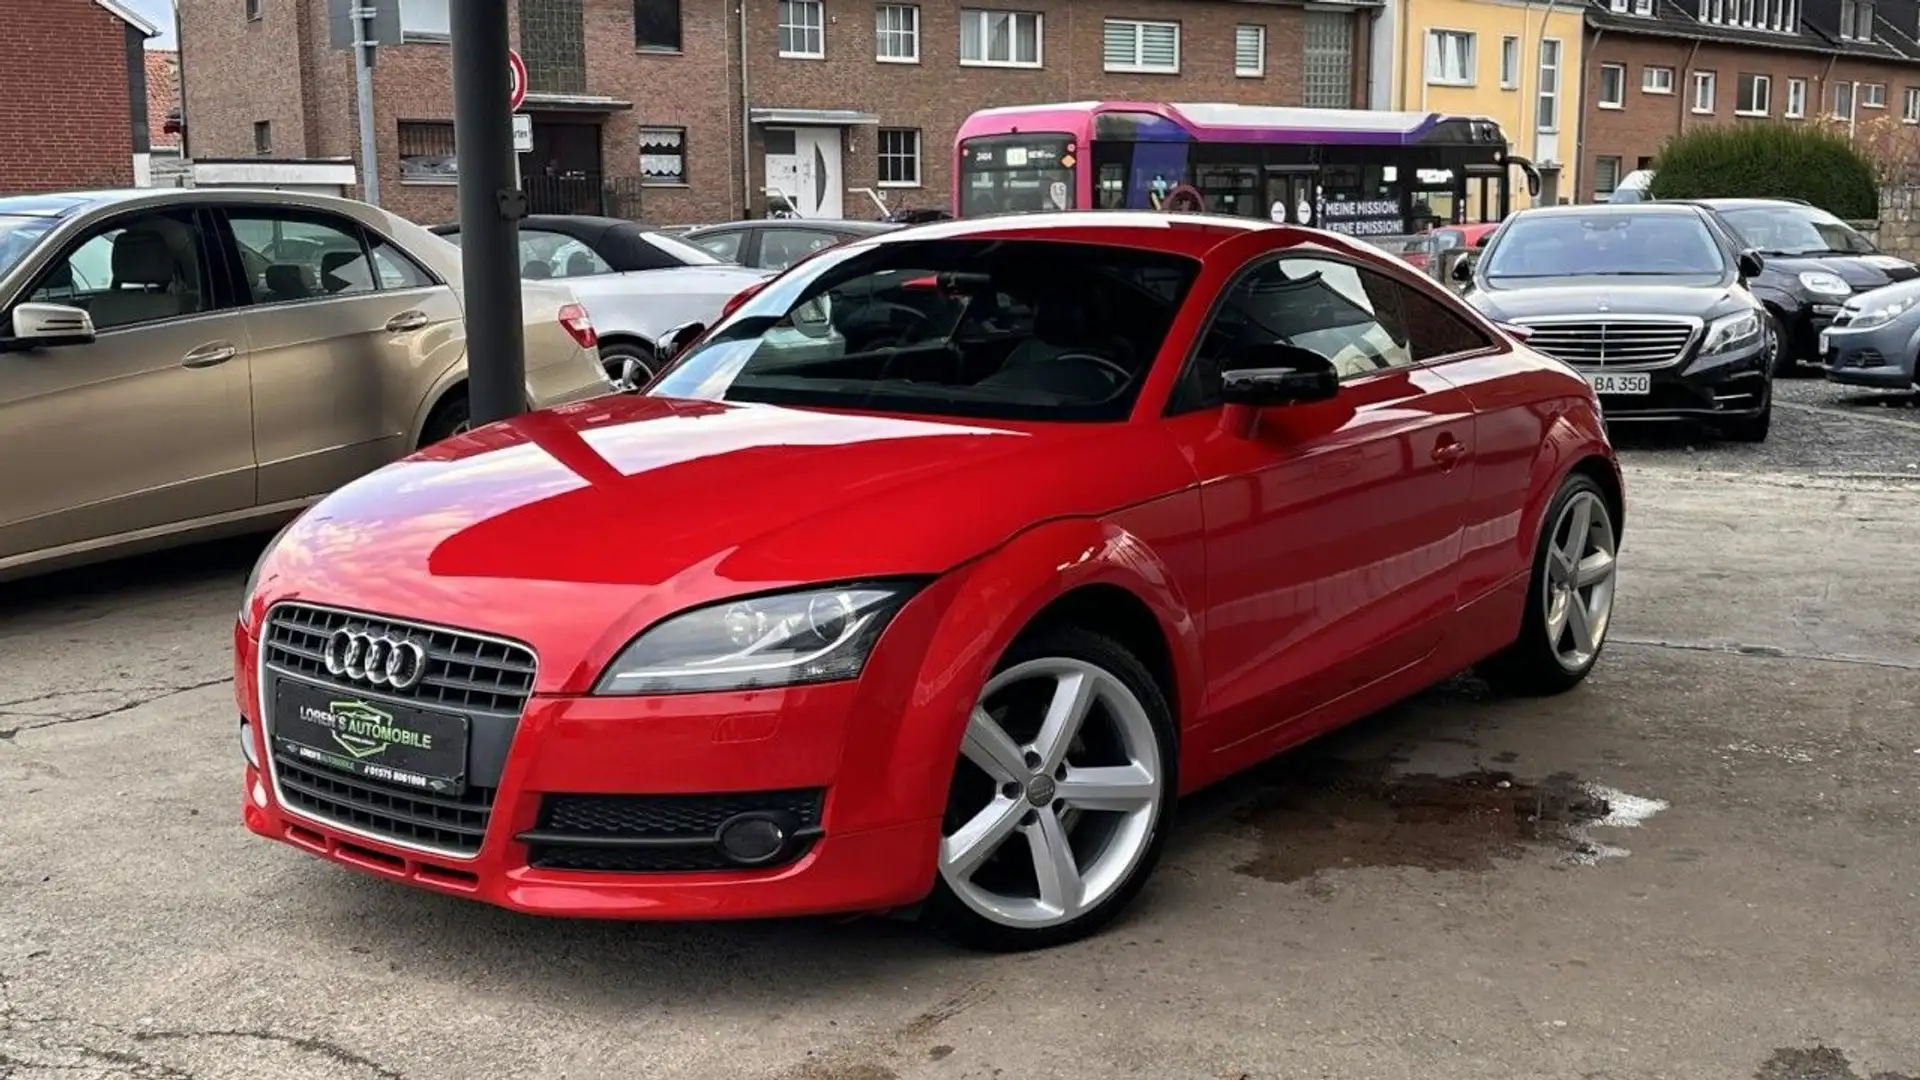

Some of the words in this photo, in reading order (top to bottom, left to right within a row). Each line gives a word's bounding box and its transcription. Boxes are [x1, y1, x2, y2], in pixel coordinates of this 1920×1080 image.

[1325, 202, 1356, 216] MEINE
[1357, 201, 1399, 215] MISSION:
[1326, 221, 1355, 235] KEINE
[1594, 376, 1615, 391] BA
[1618, 376, 1648, 391] 350
[300, 705, 348, 730] LOREN'S
[348, 720, 432, 750] AUTOMOBILE
